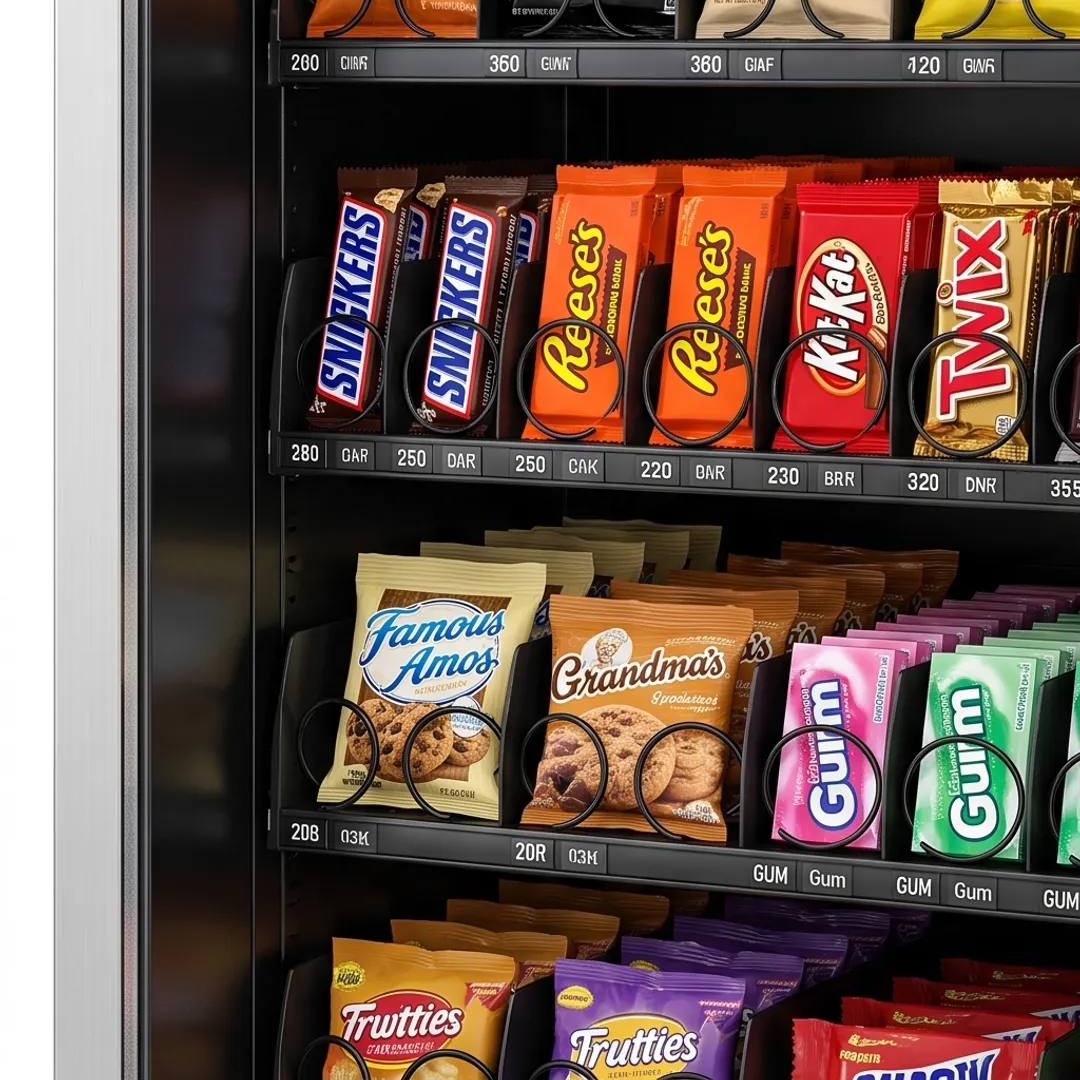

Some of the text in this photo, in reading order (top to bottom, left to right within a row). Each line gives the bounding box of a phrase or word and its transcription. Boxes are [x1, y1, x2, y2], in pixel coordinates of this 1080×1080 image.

[489, 54, 520, 72] 360
[690, 55, 722, 74] 360
[543, 220, 603, 391] Reese's
[671, 223, 732, 395] Reese's
[291, 443, 319, 462] 280
[398, 449, 427, 467] 250
[515, 455, 546, 474] 250
[640, 461, 672, 479] 220
[767, 467, 800, 486] 230
[907, 473, 939, 492] 320
[360, 605, 506, 666] Famous
[380, 645, 499, 693] Amos
[552, 648, 724, 701] Grandma's
[753, 864, 789, 885] GUM
[809, 869, 847, 889] Gum
[896, 876, 932, 898] GUM
[954, 882, 993, 902] Gum
[1043, 890, 1080, 912] GUM
